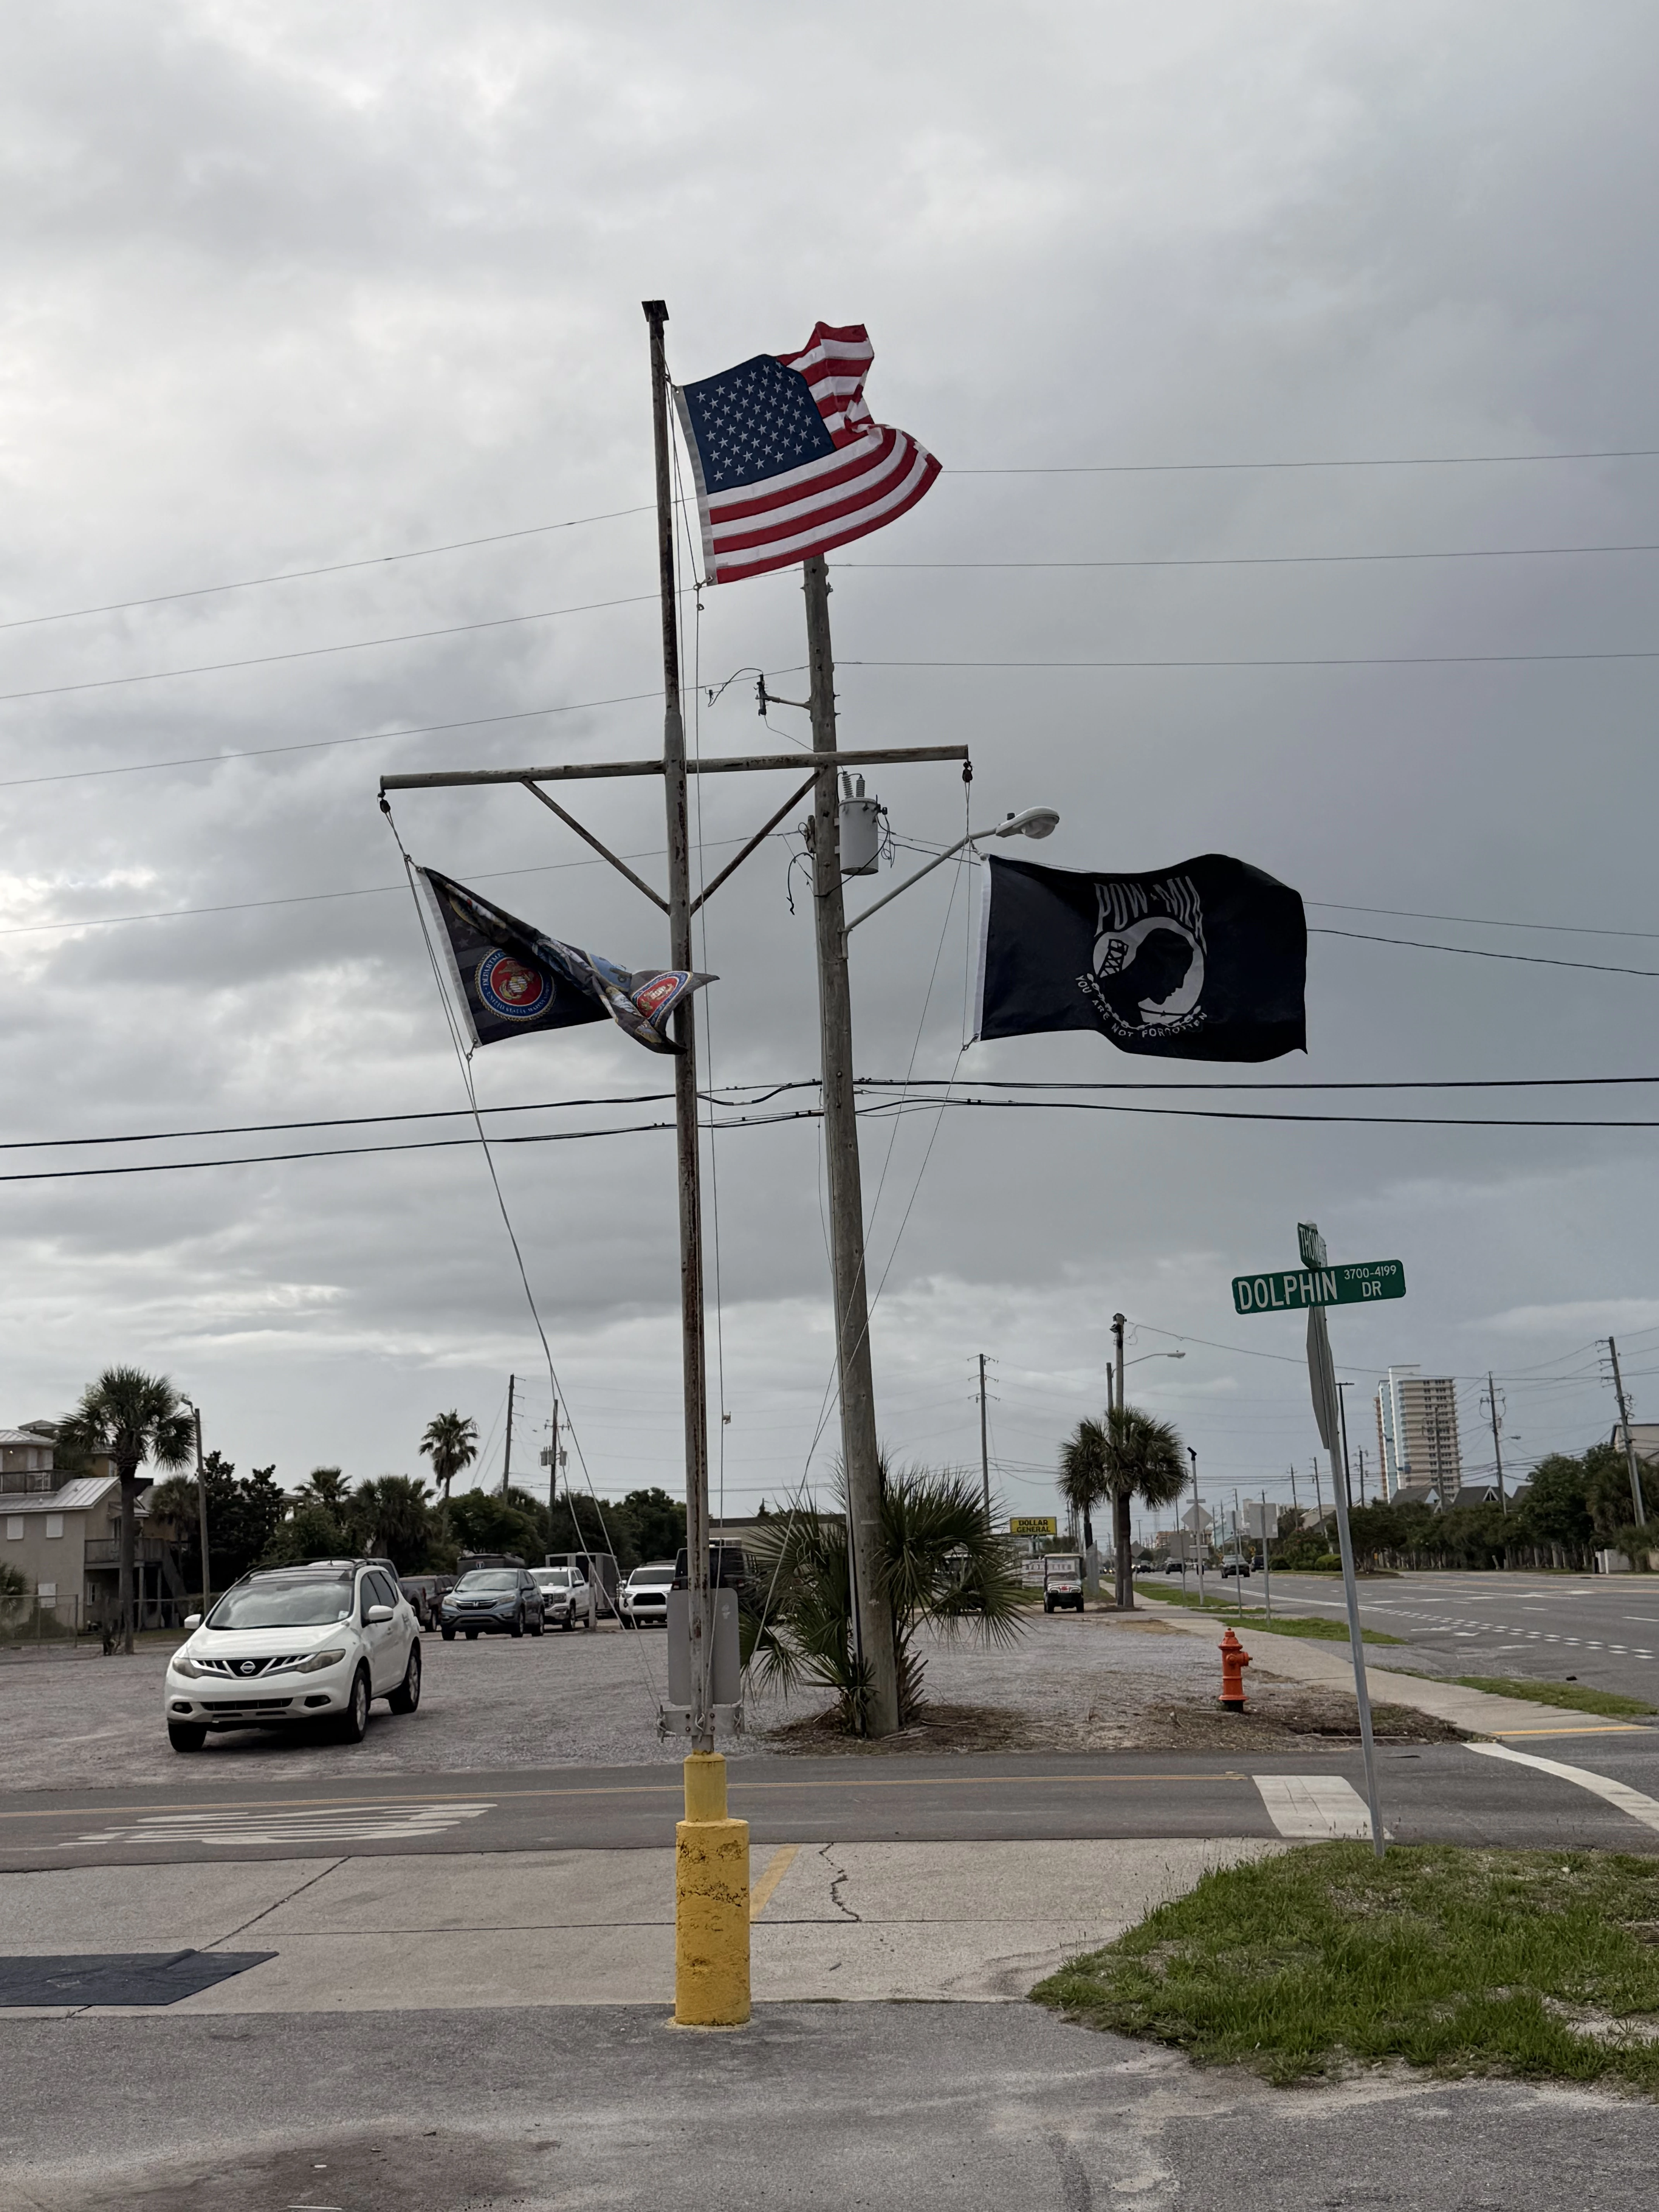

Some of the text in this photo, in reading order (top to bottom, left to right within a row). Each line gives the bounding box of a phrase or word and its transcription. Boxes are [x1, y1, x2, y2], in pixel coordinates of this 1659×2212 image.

[1094, 876, 1207, 956] POW MIA
[1075, 975, 1092, 993] YOU
[1092, 1000, 1111, 1020] ARE
[1111, 1023, 1134, 1037] NOT
[1237, 1265, 1397, 1310] DOLPHIN 3700-4199
[1362, 1281, 1382, 1297] DR
